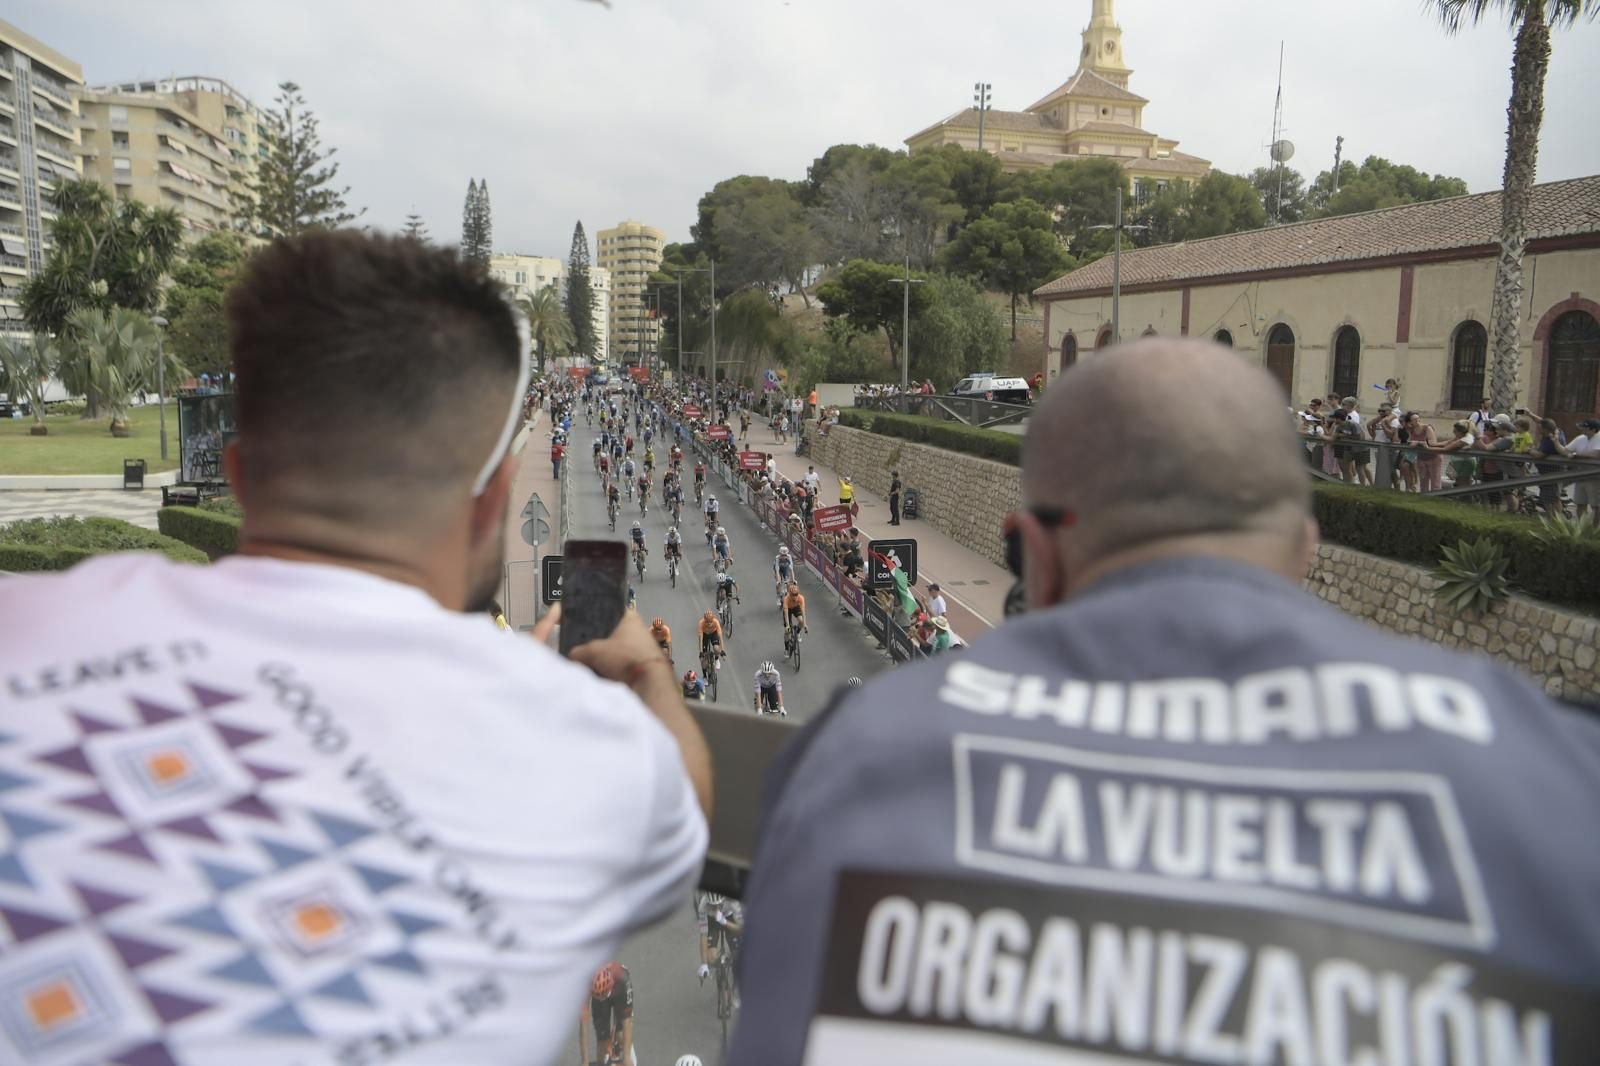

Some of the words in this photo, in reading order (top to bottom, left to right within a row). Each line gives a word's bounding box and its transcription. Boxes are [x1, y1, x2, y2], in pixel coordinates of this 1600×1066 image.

[256, 661, 350, 757] GOOD
[937, 659, 1496, 745] SHIMANO
[990, 763, 1088, 863] LA
[1097, 781, 1434, 905] VUELTA
